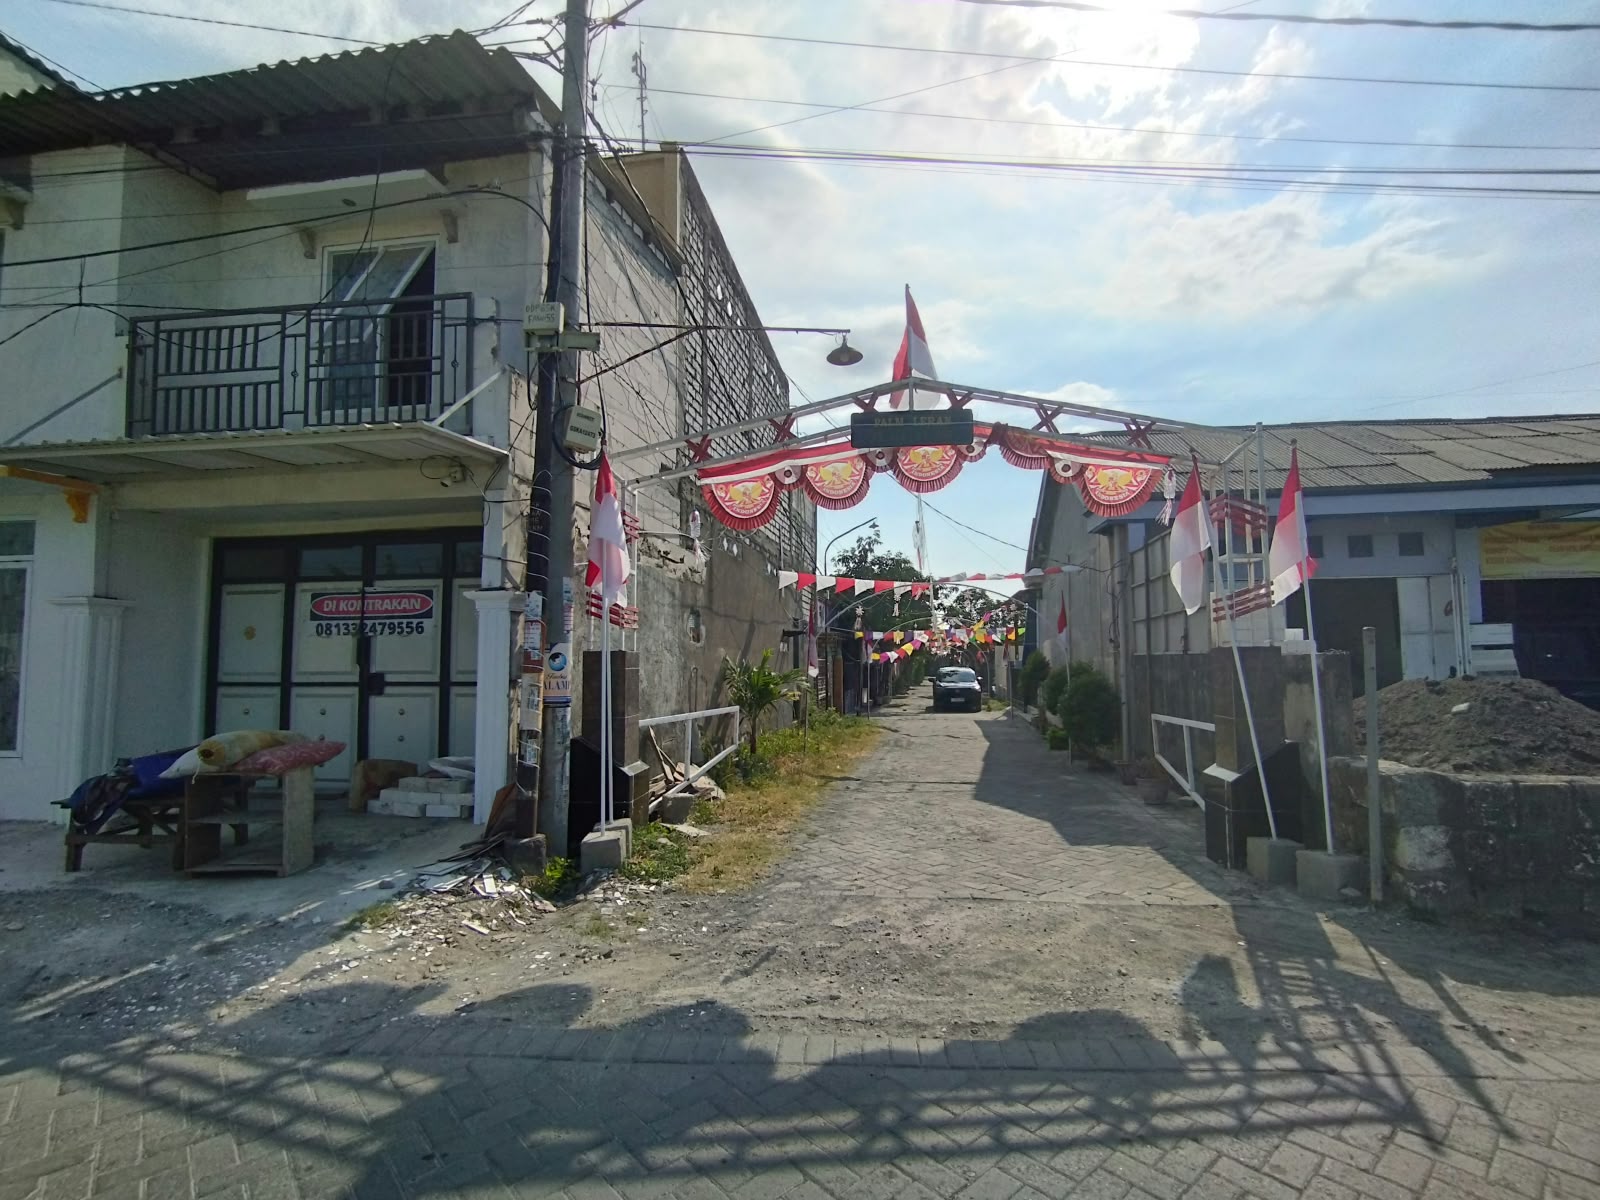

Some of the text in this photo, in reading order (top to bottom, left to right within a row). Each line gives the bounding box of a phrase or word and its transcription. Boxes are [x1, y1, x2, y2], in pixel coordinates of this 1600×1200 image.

[1095, 488, 1130, 501] INDONESIA
[324, 598, 421, 612] DI KONTRAKAN
